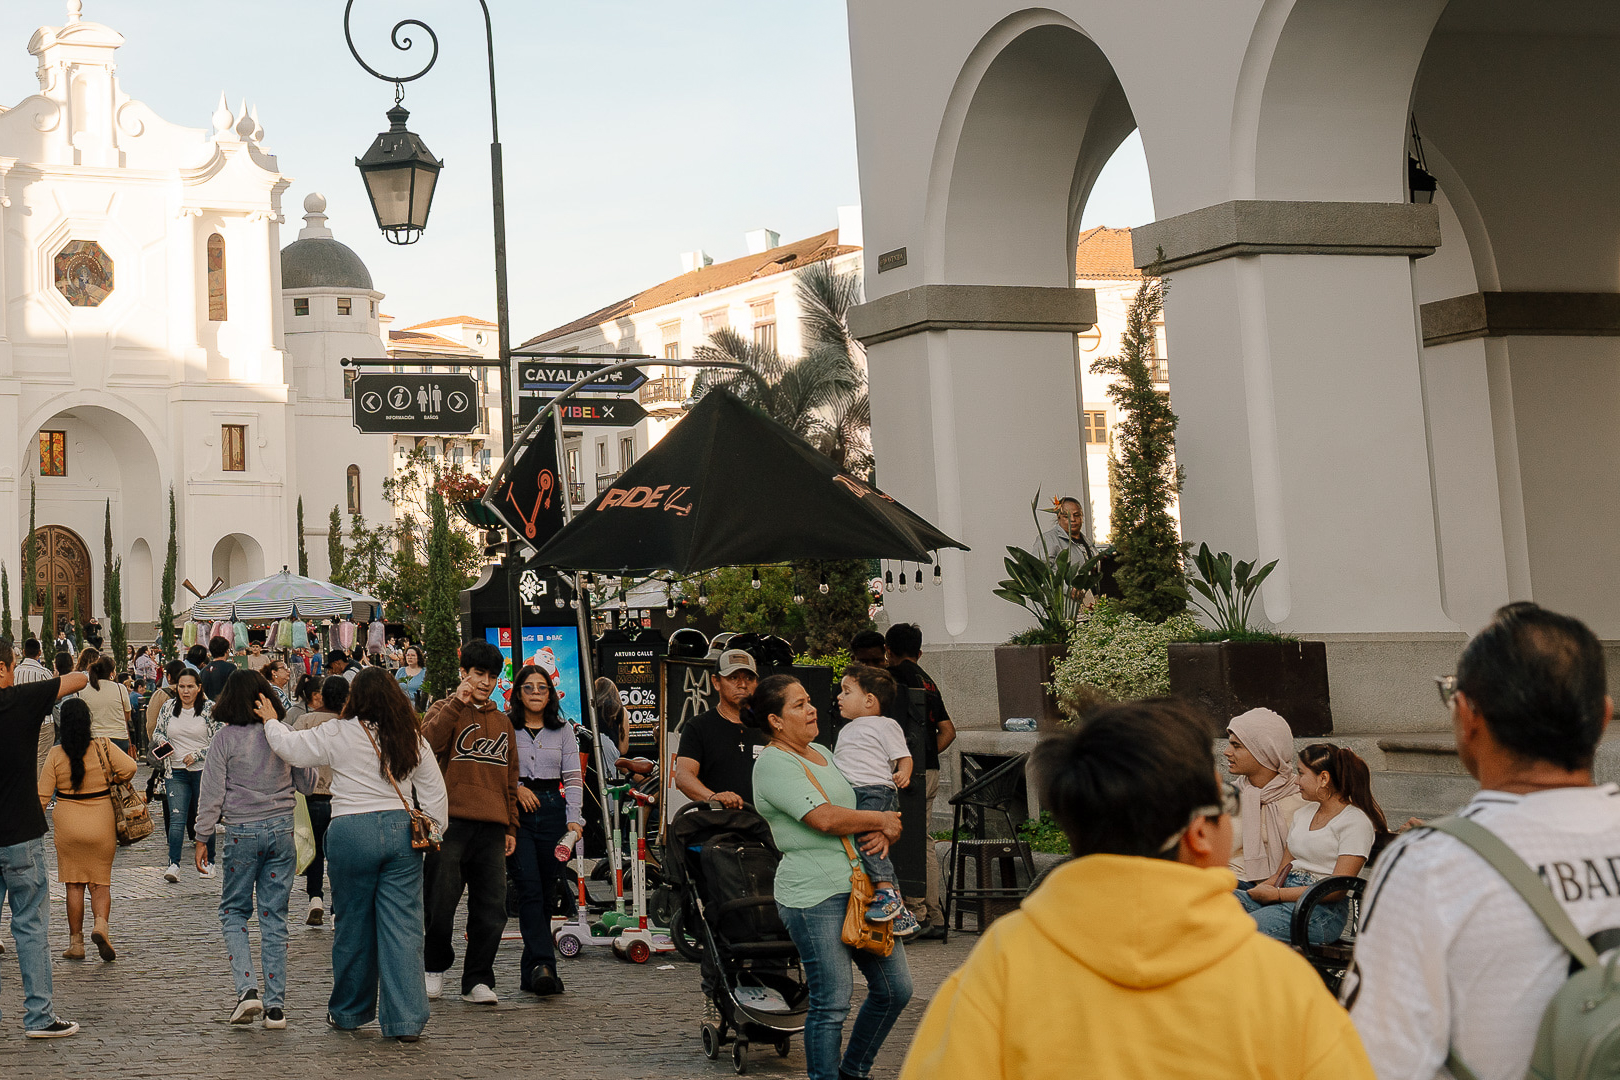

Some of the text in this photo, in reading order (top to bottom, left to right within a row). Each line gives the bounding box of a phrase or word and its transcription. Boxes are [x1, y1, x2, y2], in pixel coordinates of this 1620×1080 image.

[538, 406, 600, 418] YIBEL
[596, 484, 671, 511] RIDE
[617, 665, 653, 675] BLACK
[615, 674, 655, 684] MONTH
[1539, 856, 1620, 902] BA
